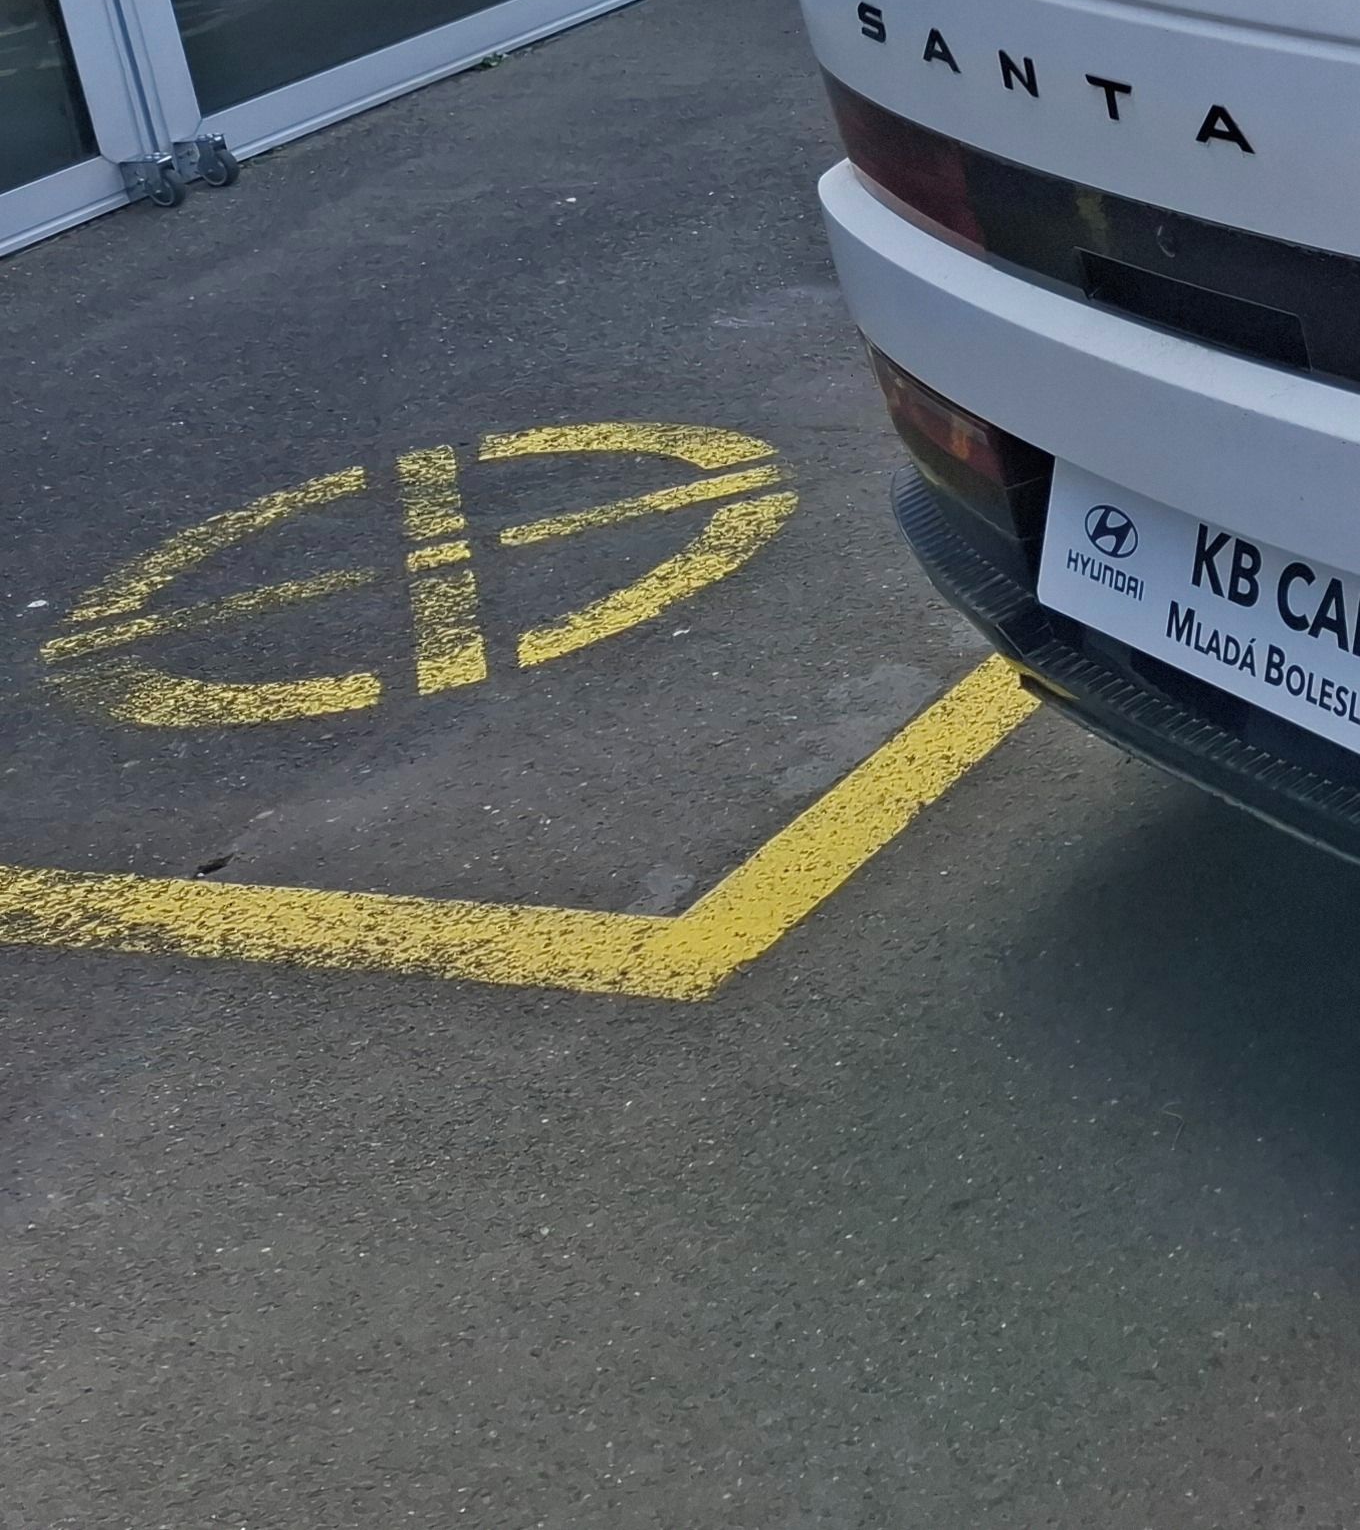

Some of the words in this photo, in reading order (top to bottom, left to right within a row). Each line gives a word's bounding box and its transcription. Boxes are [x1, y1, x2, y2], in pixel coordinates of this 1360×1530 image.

[856, 0, 1256, 155] SANTA
[1066, 547, 1145, 602] HYUNDAI
[1190, 522, 1263, 608] KB
